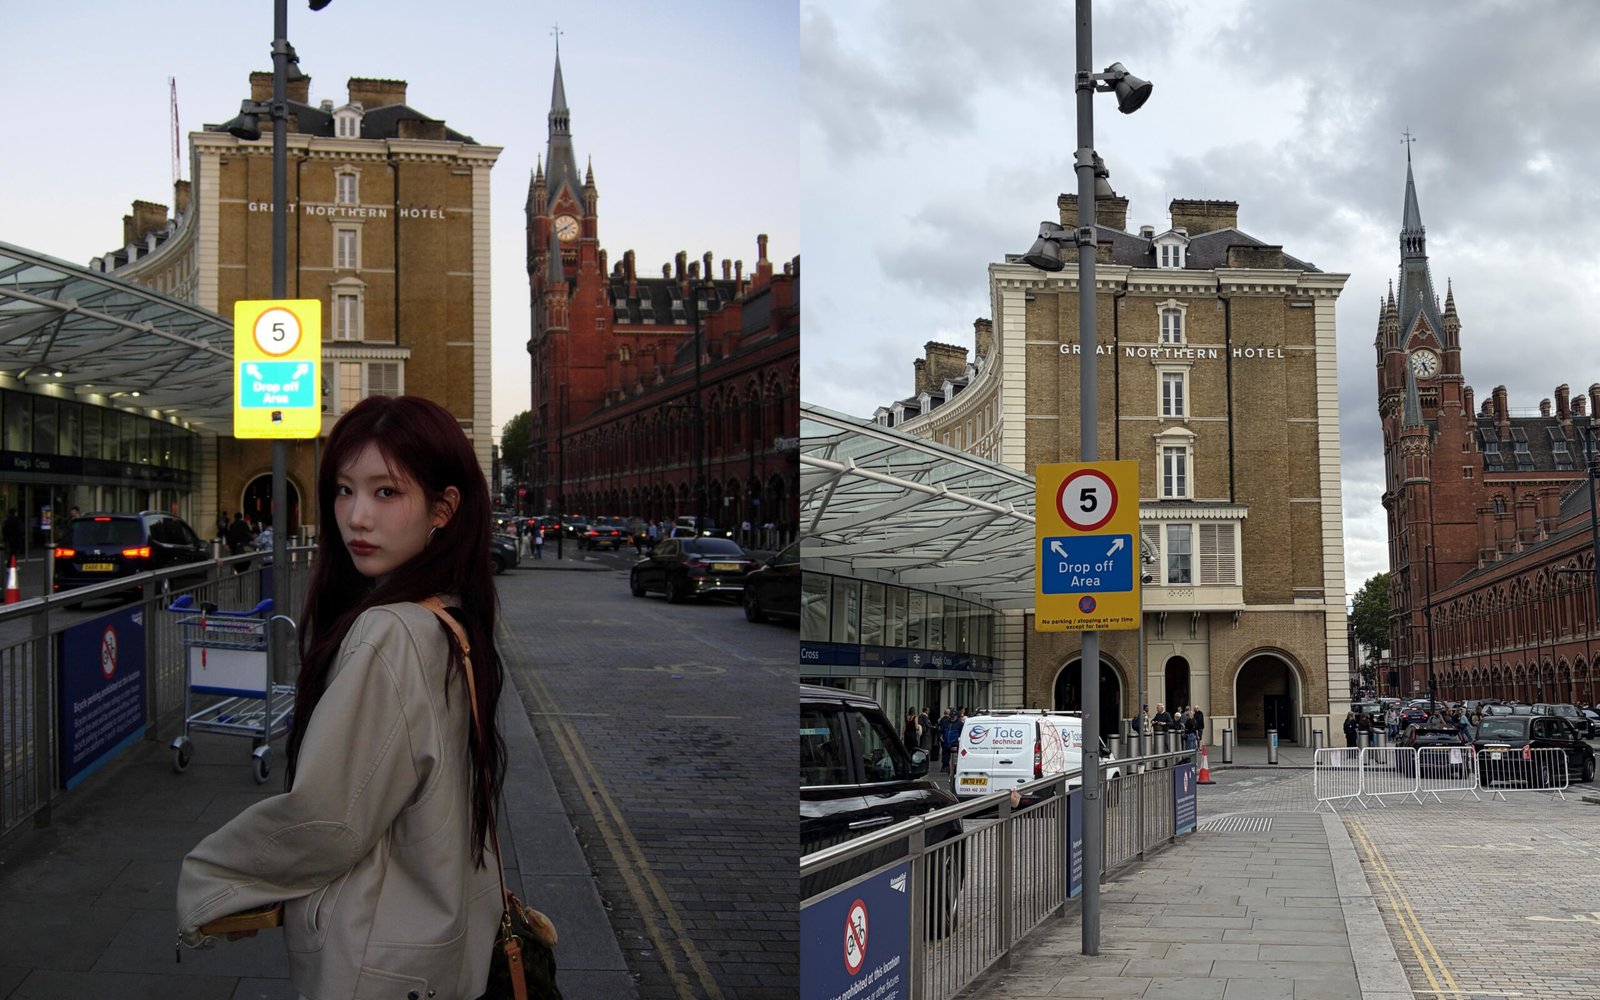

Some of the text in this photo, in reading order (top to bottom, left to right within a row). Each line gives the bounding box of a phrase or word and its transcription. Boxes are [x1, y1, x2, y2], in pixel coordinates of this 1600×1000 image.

[306, 206, 388, 219] NORTHERN
[400, 208, 446, 219] HOTEL
[273, 323, 285, 341] 5
[1060, 344, 1285, 359] GRAT NORTHERN HOTEL
[253, 381, 299, 393] Drop off
[263, 393, 288, 404] Area
[1080, 488, 1097, 512] 5
[1059, 560, 1113, 574] Drop off
[1071, 576, 1100, 587] Area
[801, 648, 819, 660] Cross
[994, 727, 1023, 738] Tate
[842, 955, 900, 1000] prohibited at this location
